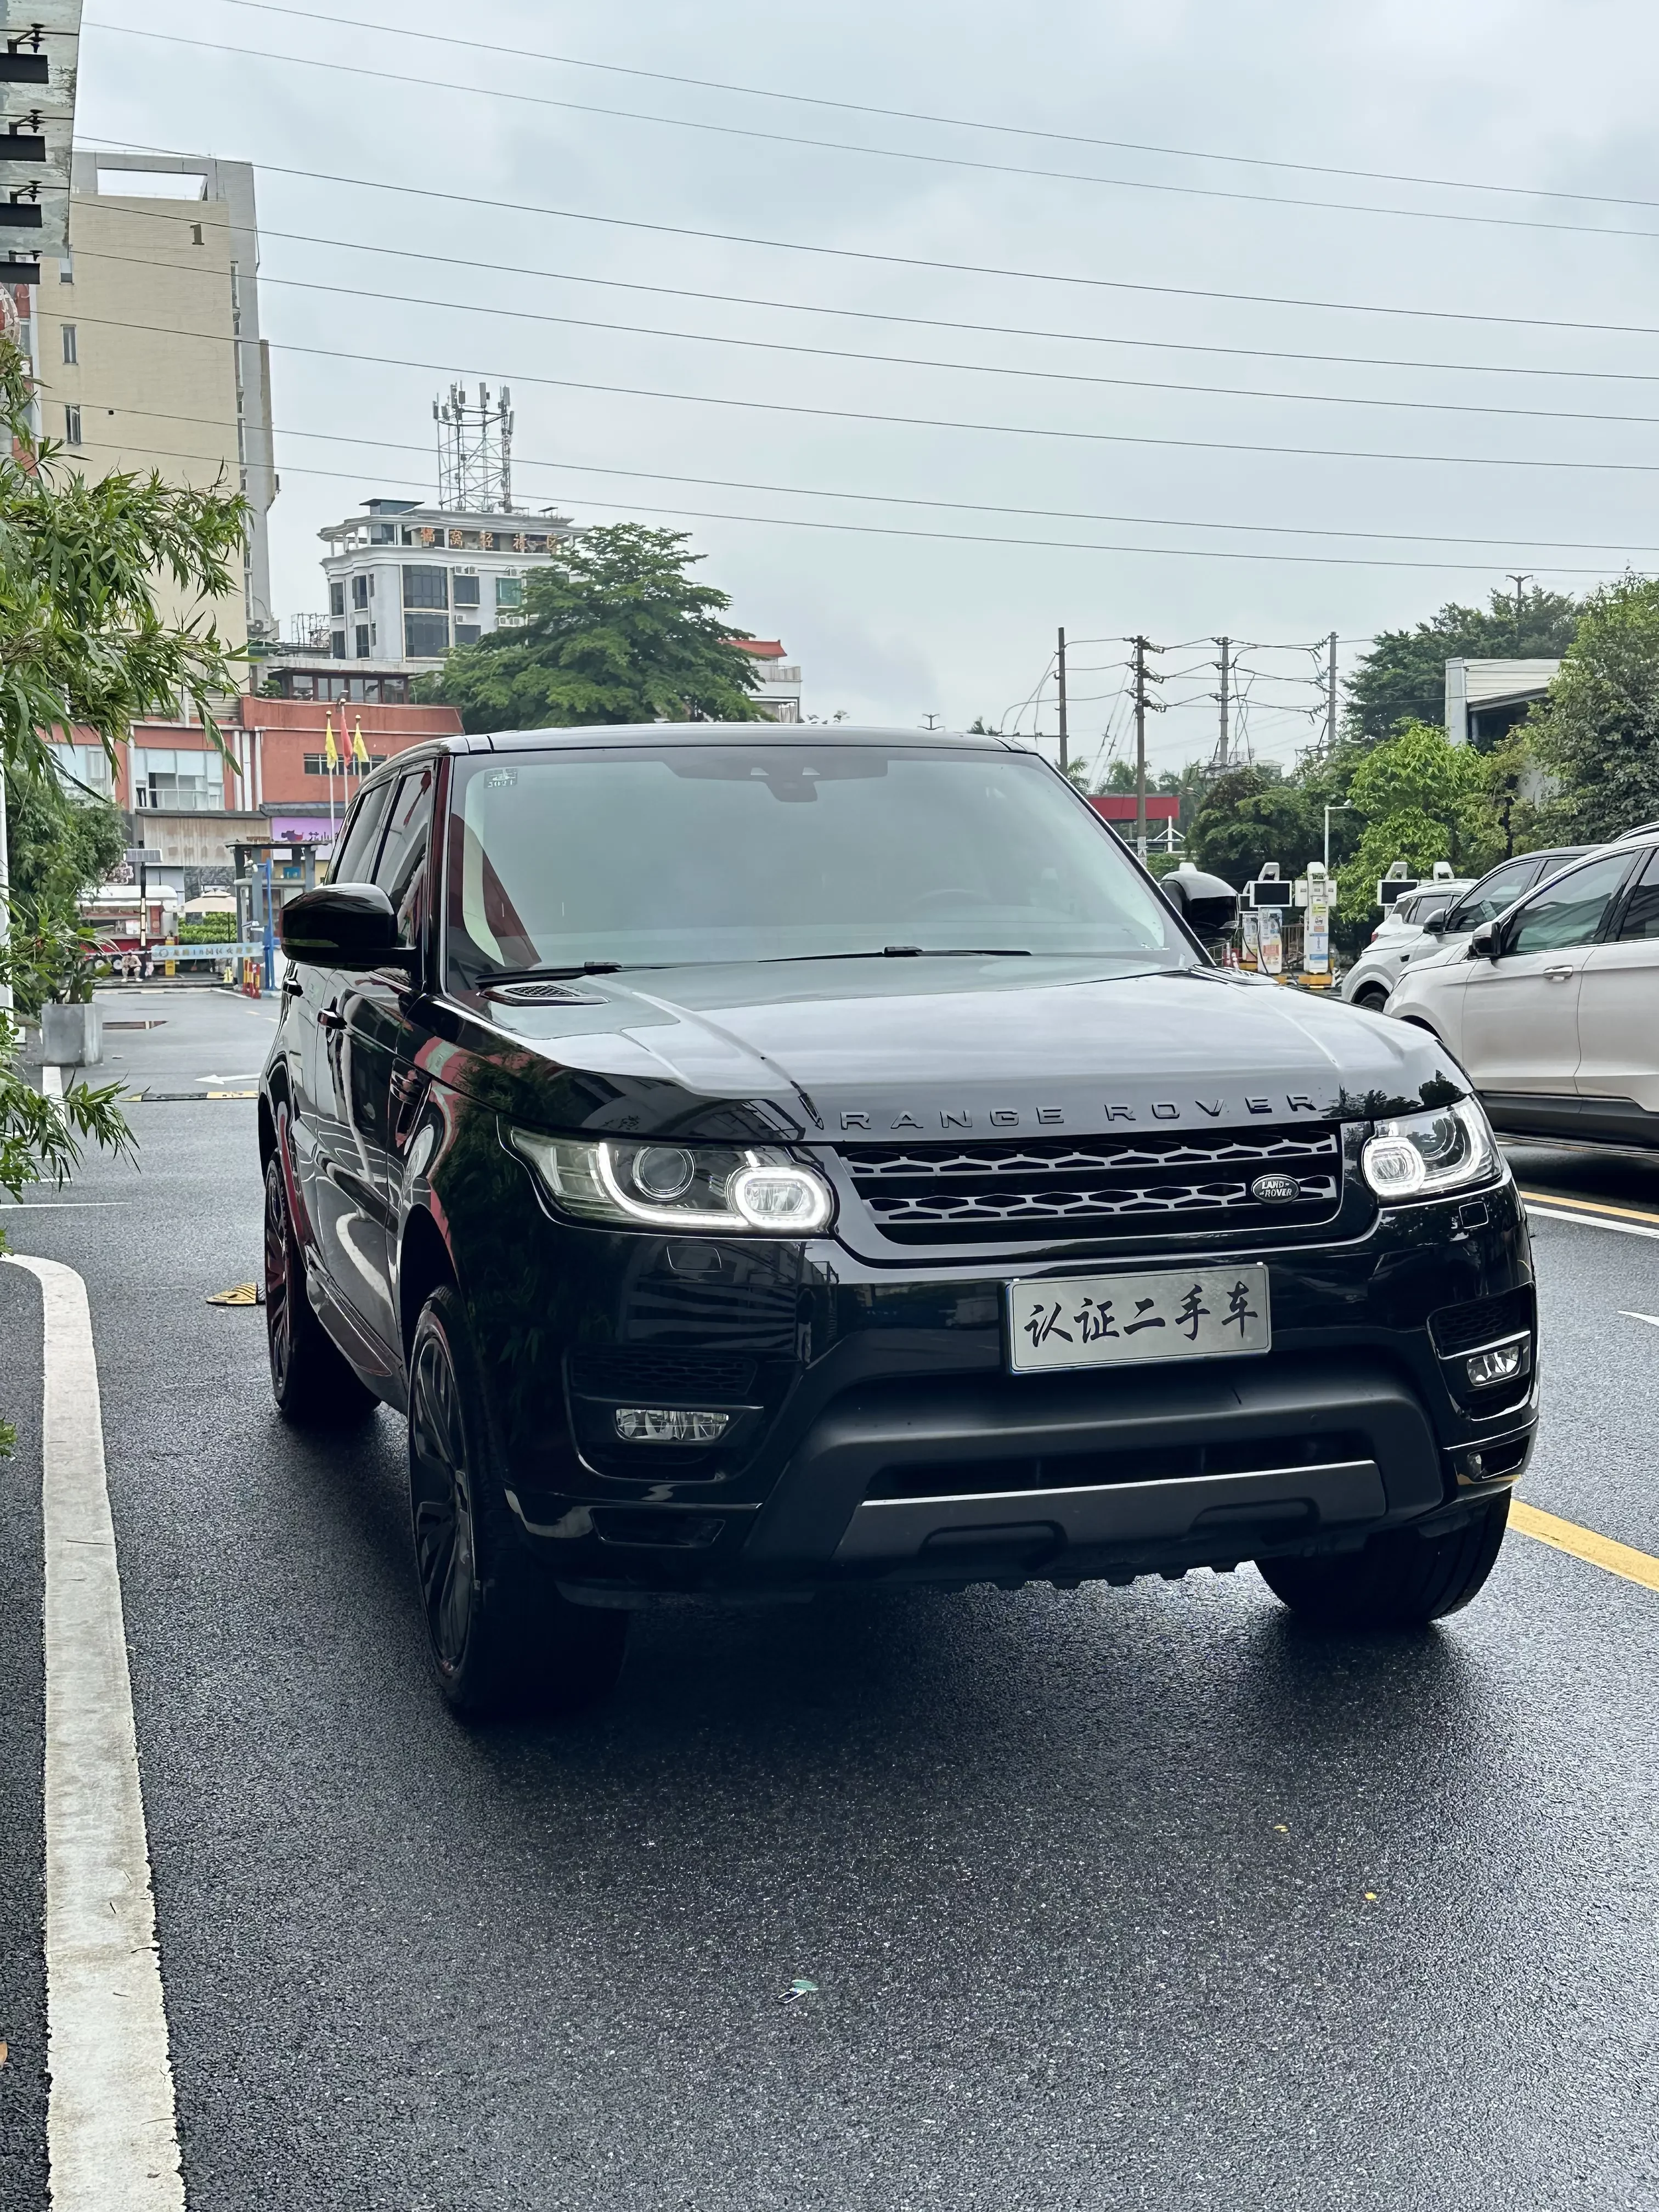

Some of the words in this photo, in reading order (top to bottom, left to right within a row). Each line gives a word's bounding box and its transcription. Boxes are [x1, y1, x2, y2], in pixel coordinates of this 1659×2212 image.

[190, 224, 205, 245] 1
[840, 1106, 1064, 1130] RANGE
[1104, 1094, 1317, 1121] ROVER
[1024, 1280, 1259, 1348] 认证二手车
